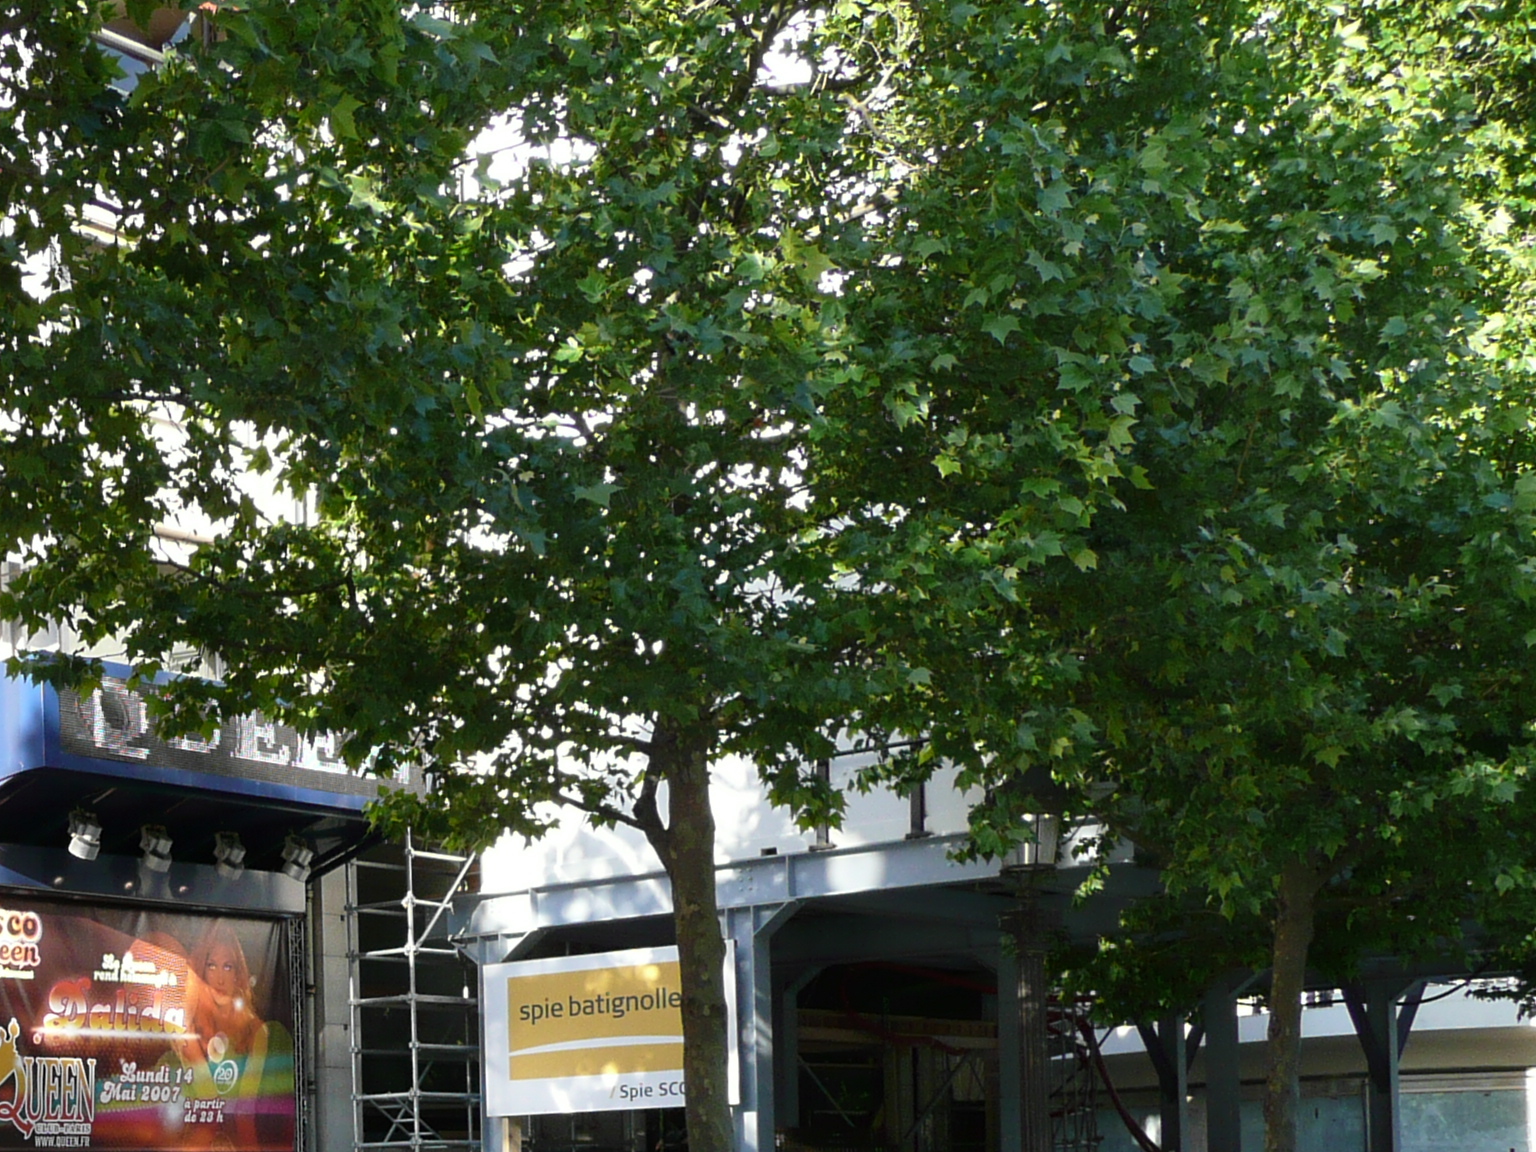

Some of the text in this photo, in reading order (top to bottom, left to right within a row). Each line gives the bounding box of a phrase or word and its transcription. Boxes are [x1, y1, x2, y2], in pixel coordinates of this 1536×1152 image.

[43, 977, 187, 1035] Dalida
[519, 987, 681, 1025] spie batignolle
[119, 1059, 193, 1085] Lundi 14
[100, 1081, 181, 1104] Mai 2007
[619, 1083, 653, 1101] Spie
[193, 1097, 225, 1112] partir
[184, 1112, 198, 1123] de
[215, 1111, 224, 1123] h
[34, 1135, 91, 1148] WWW.QUEEN.FR
